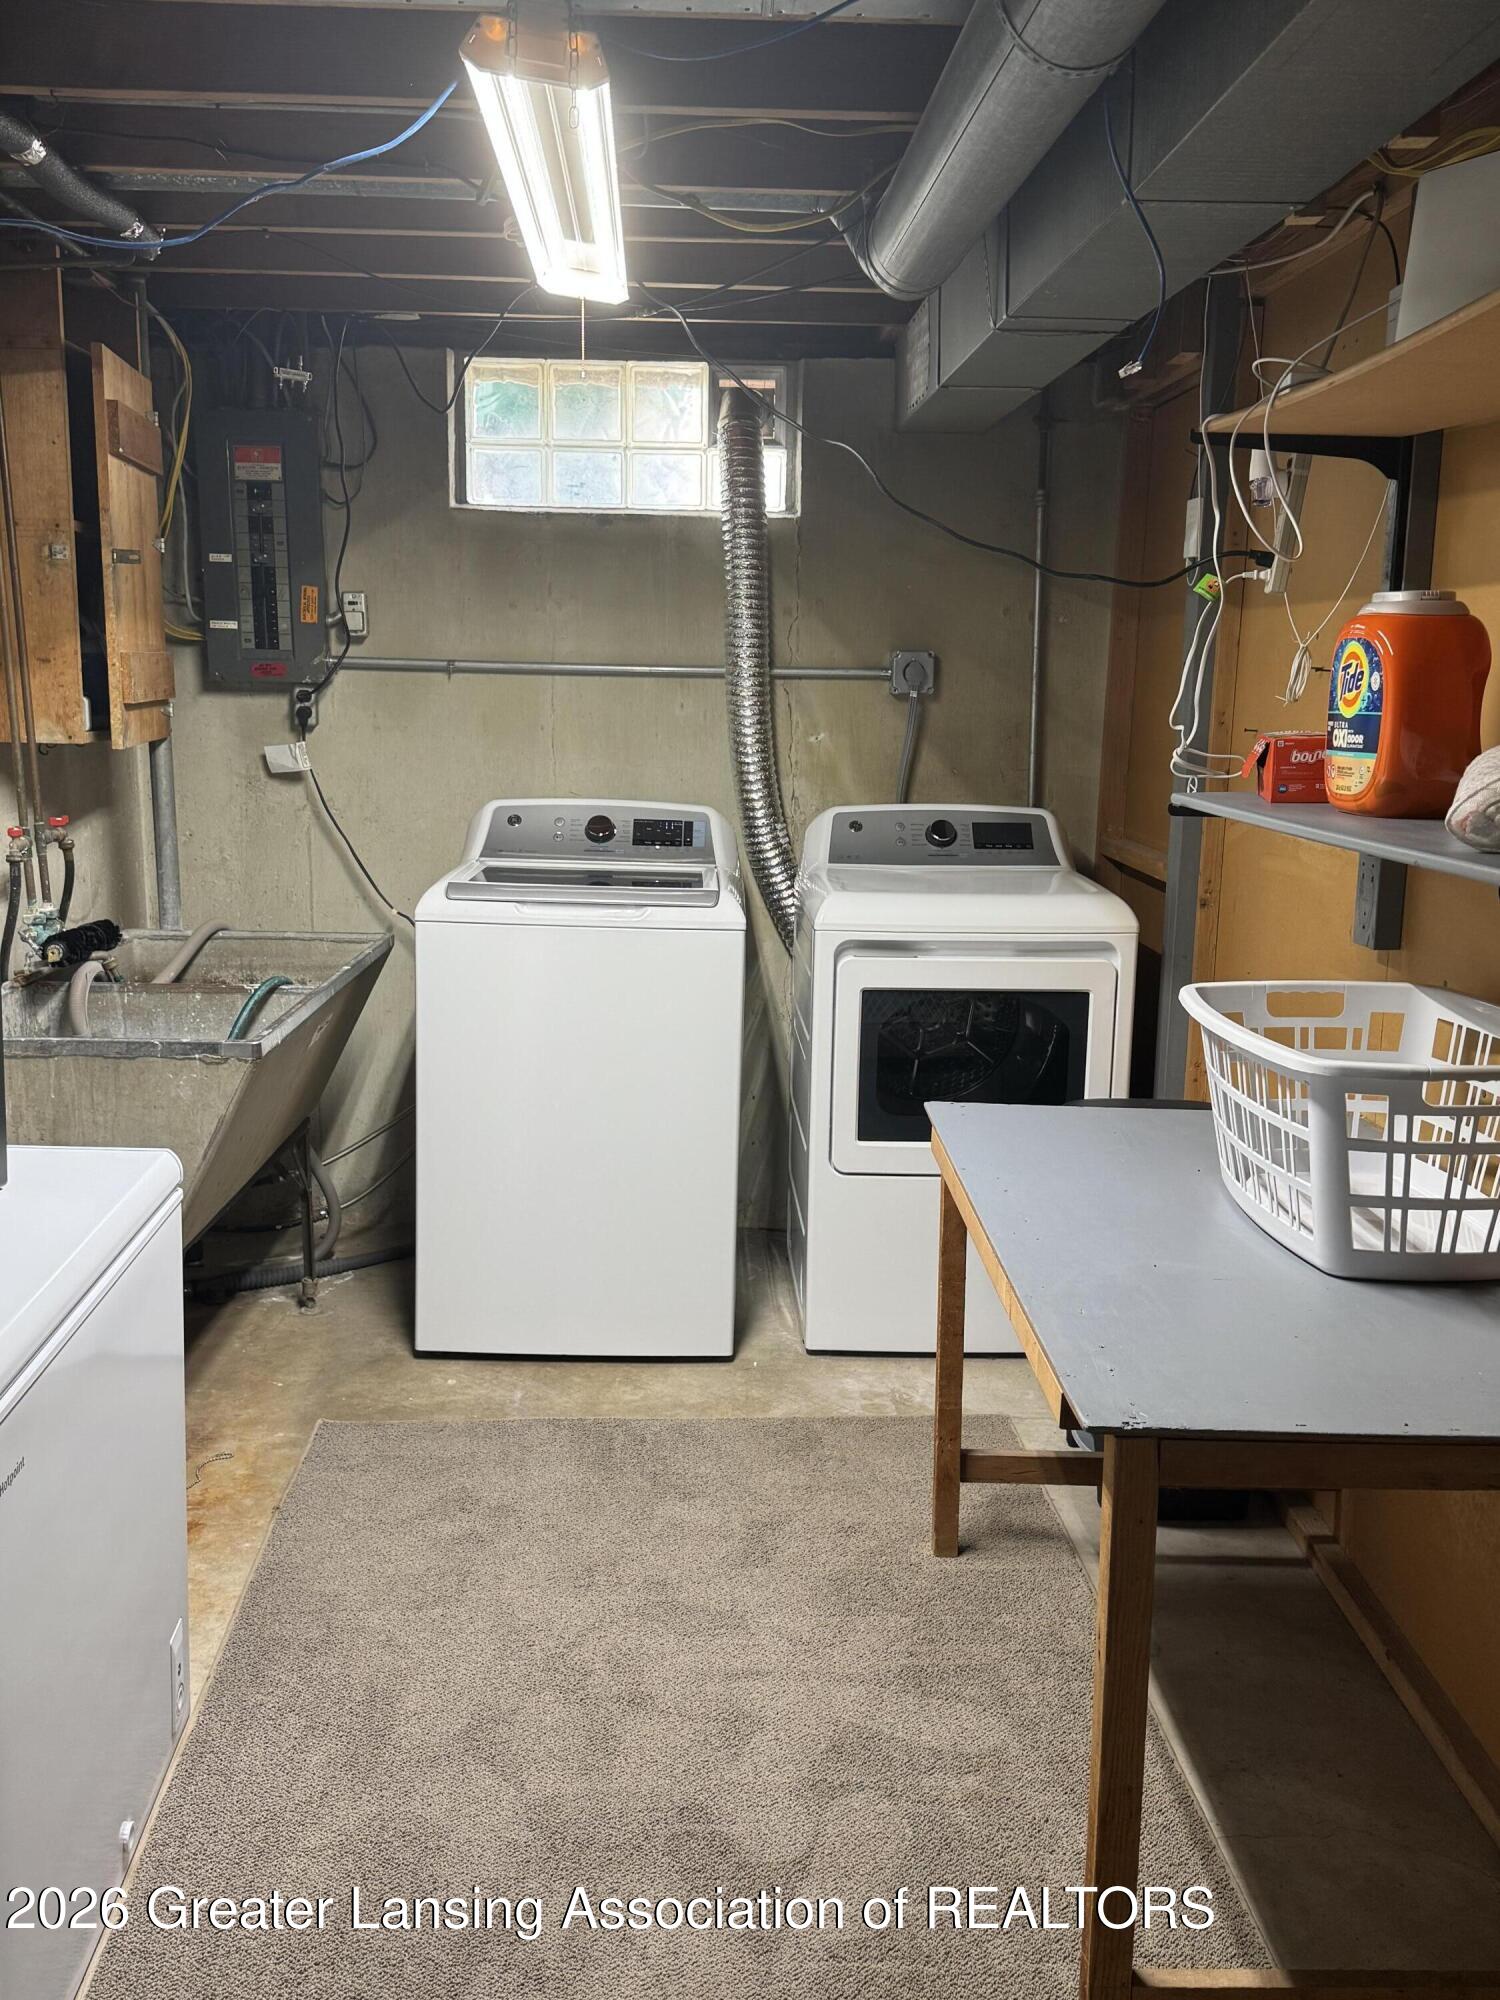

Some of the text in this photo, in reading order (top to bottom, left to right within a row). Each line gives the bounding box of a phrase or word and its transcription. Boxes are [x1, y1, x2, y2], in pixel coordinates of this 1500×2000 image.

[1340, 662, 1365, 701] Tide
[1333, 728, 1348, 748] OXI
[1347, 734, 1364, 744] ODOR
[0, 1456, 25, 1498] Hotpoint
